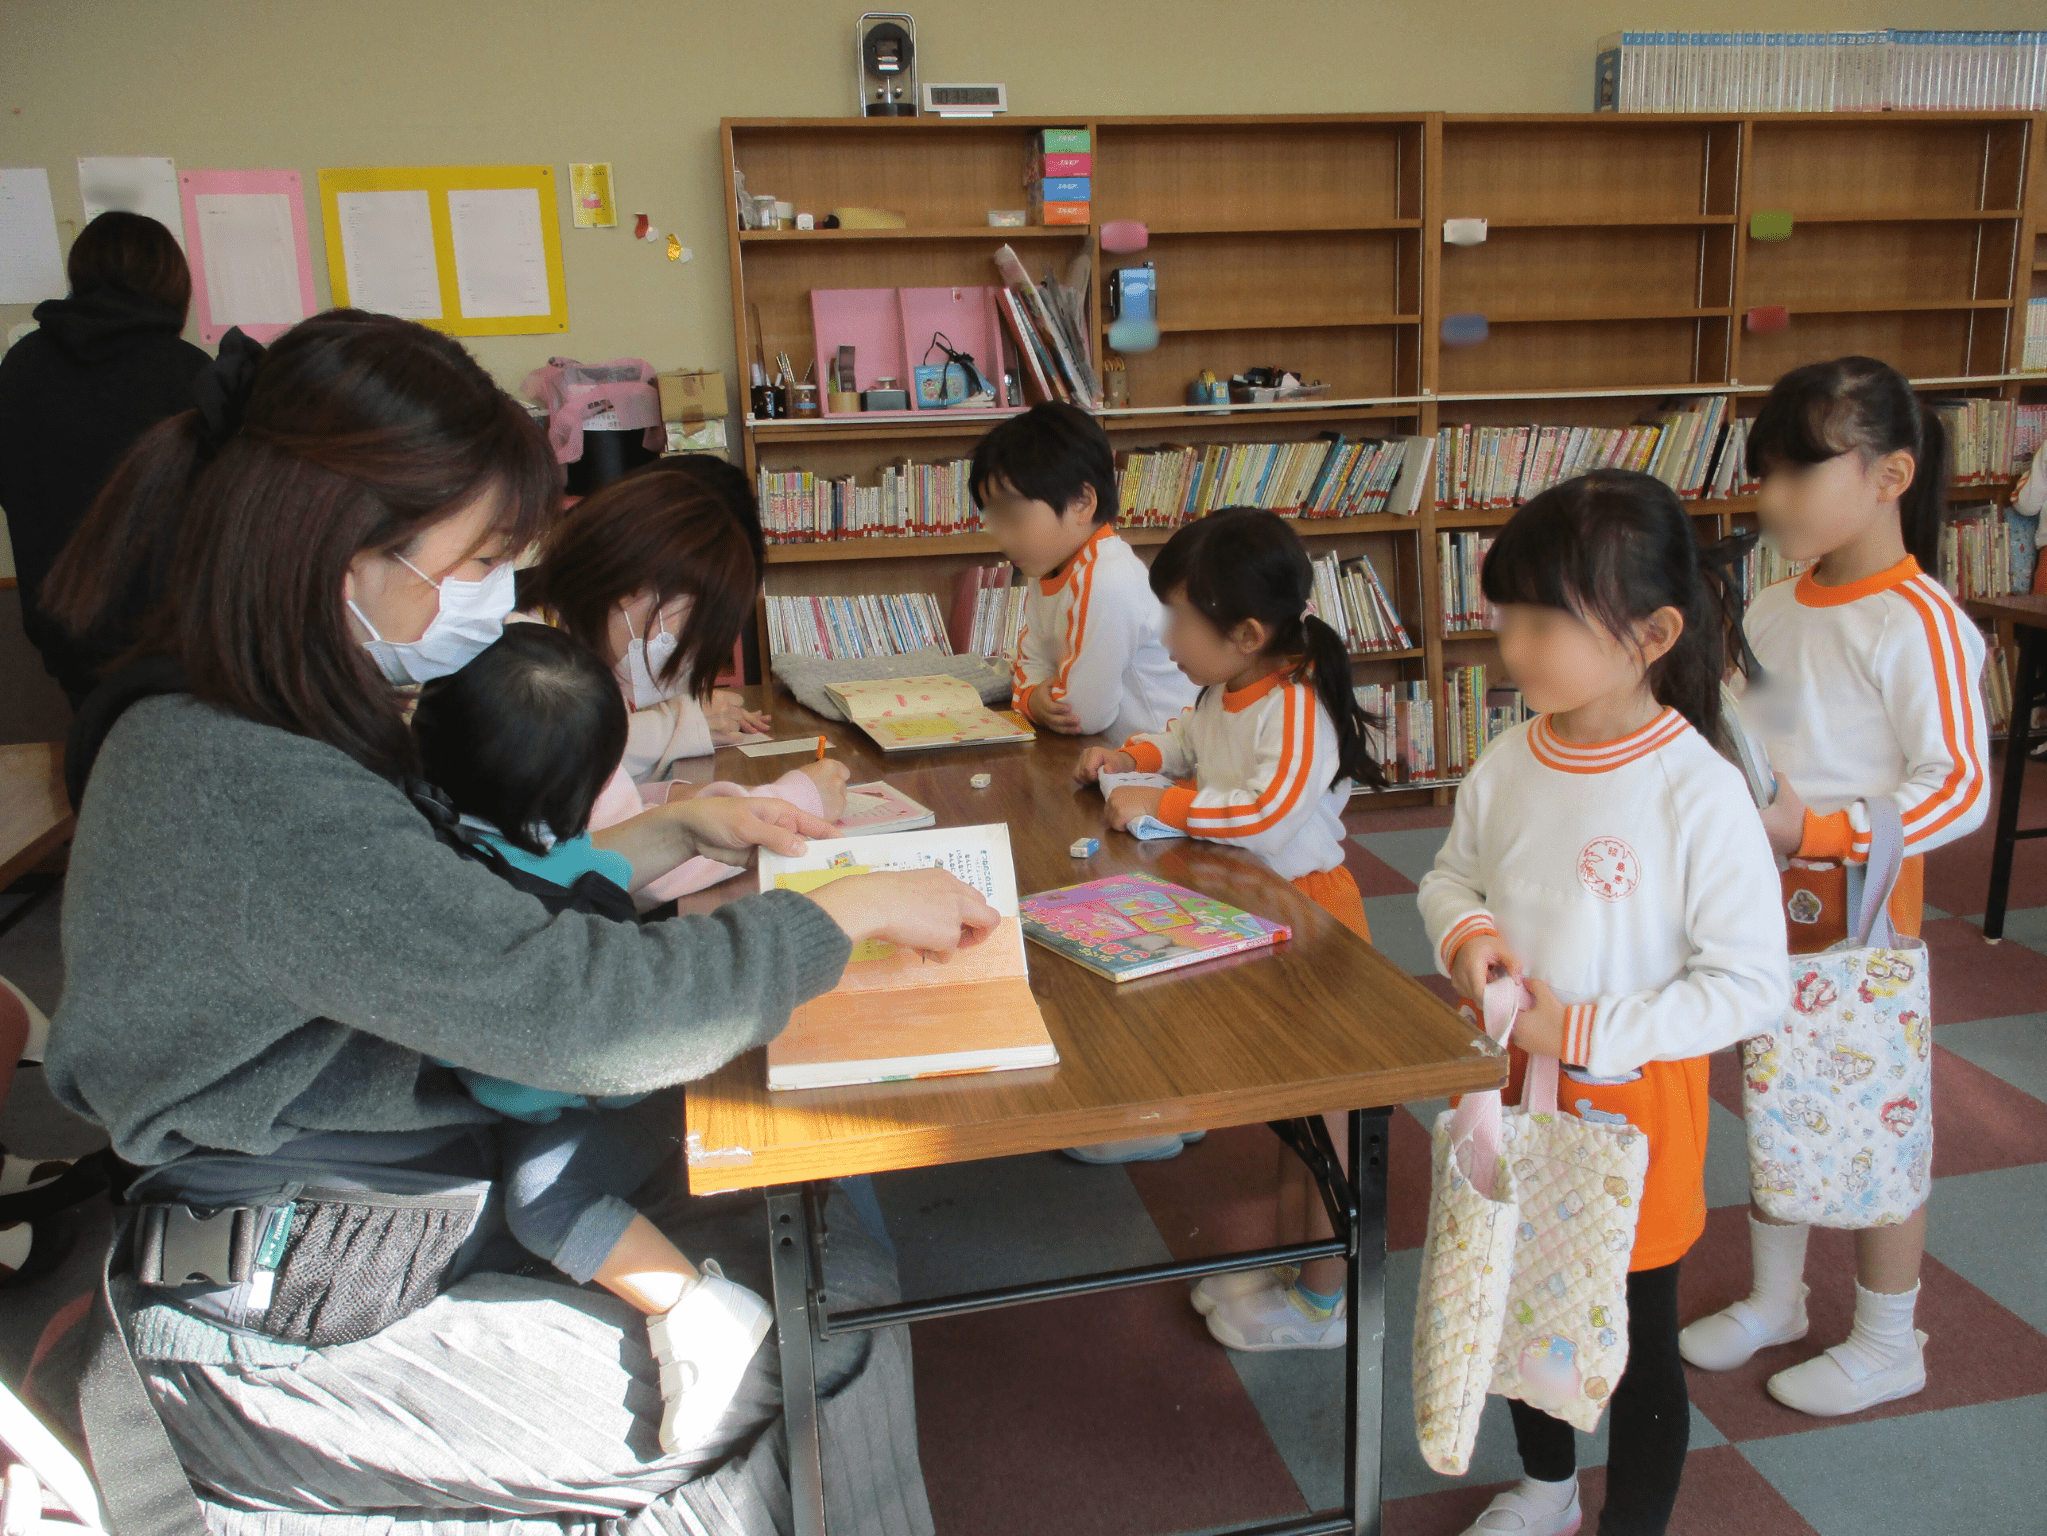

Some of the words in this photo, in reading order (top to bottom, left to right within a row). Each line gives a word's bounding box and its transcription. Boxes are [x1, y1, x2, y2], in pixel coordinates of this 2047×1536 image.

[980, 850, 994, 898] きつねのこのえほん
